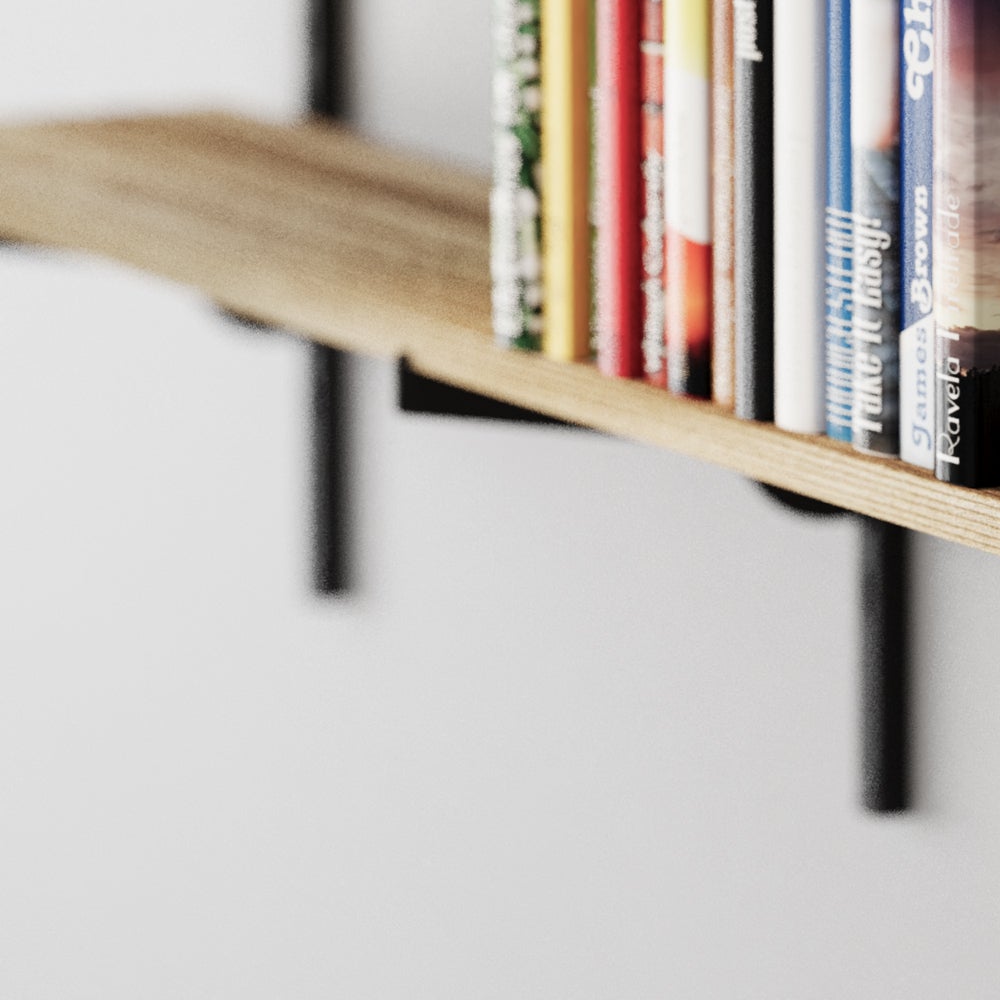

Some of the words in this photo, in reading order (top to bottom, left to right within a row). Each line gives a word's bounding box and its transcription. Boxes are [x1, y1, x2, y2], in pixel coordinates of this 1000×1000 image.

[911, 185, 933, 315] Brown
[911, 326, 932, 450] James
[936, 356, 961, 465] Ravela
